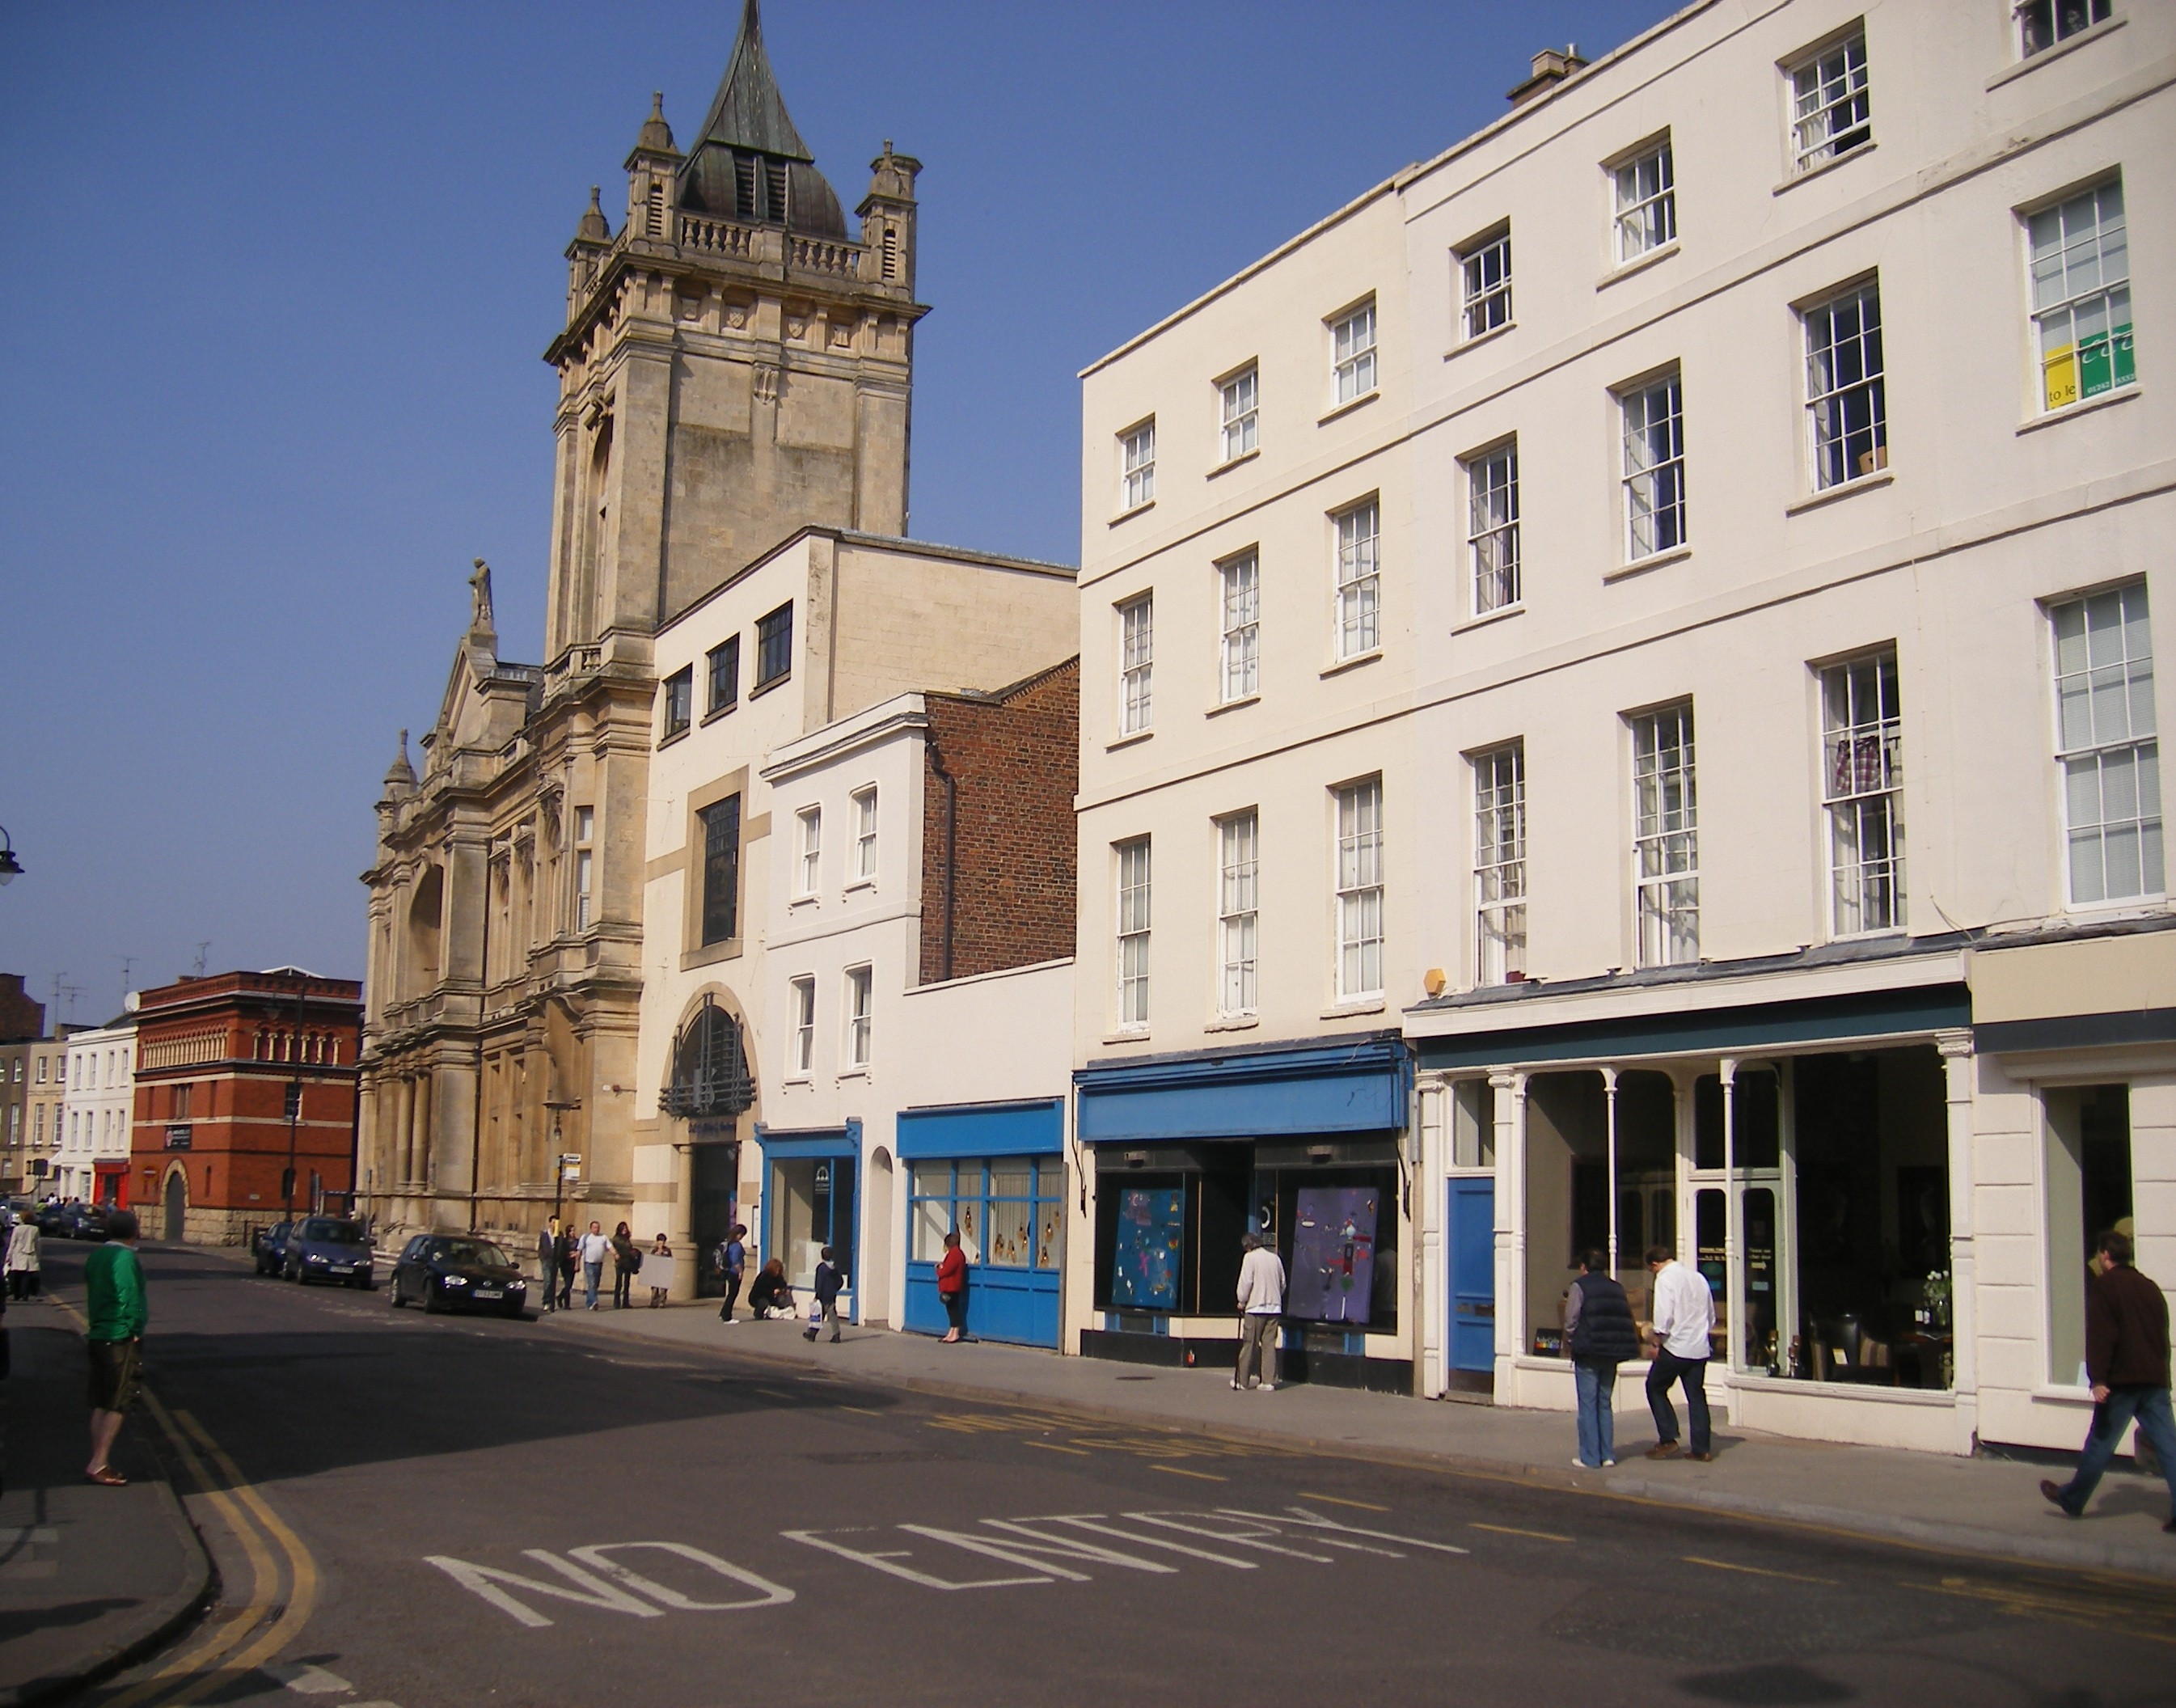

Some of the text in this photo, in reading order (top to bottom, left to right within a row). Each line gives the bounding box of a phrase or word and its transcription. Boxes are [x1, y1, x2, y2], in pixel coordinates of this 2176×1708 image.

[2048, 384, 2076, 402] to le
[422, 1507, 1470, 1627] NO ENTRY
